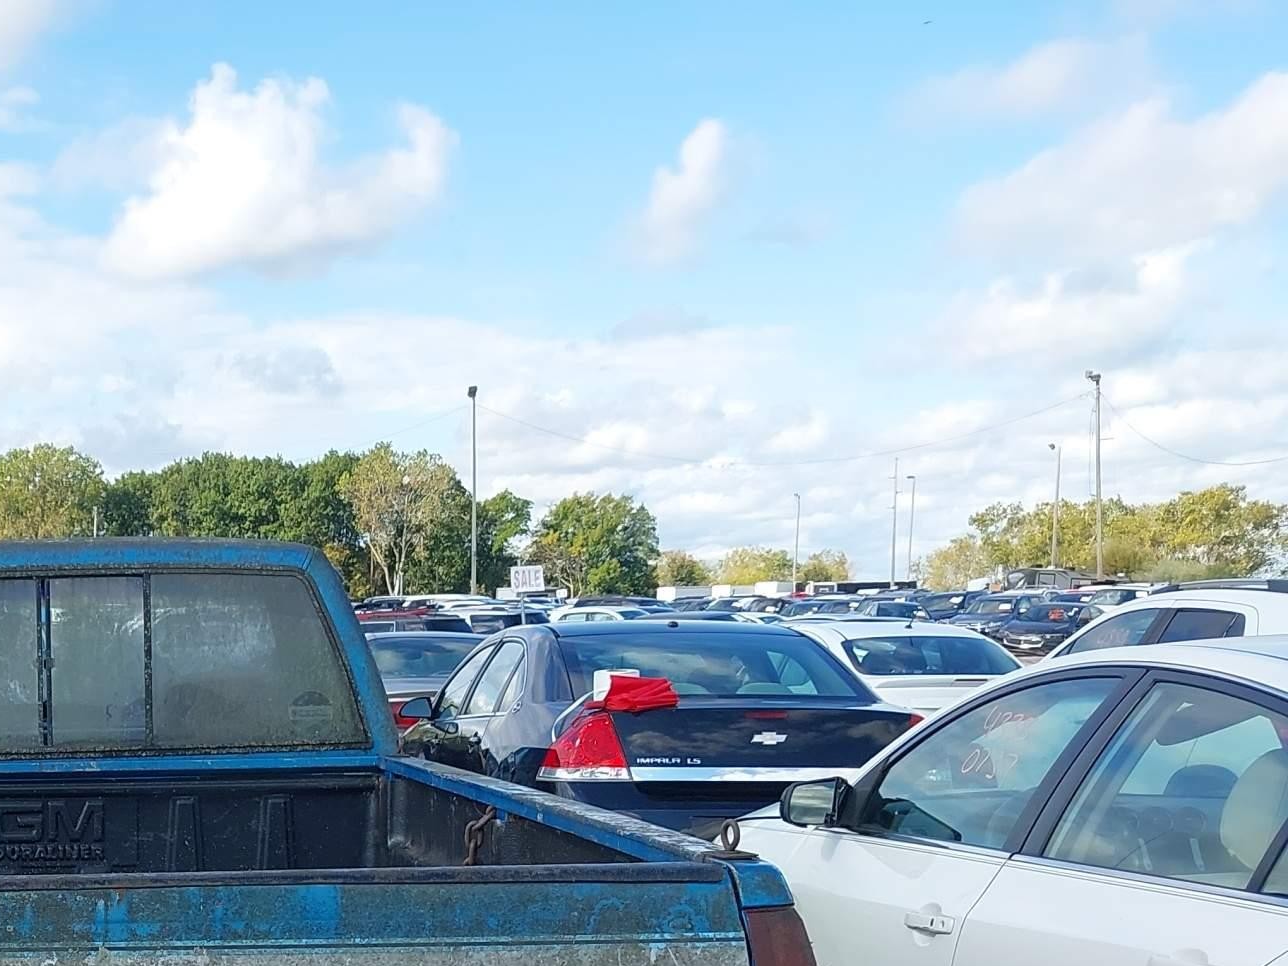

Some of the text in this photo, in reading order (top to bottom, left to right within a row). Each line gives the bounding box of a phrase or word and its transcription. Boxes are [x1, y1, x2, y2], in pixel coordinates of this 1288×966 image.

[513, 568, 542, 589] SALE
[636, 757, 701, 765] IMPALA LS
